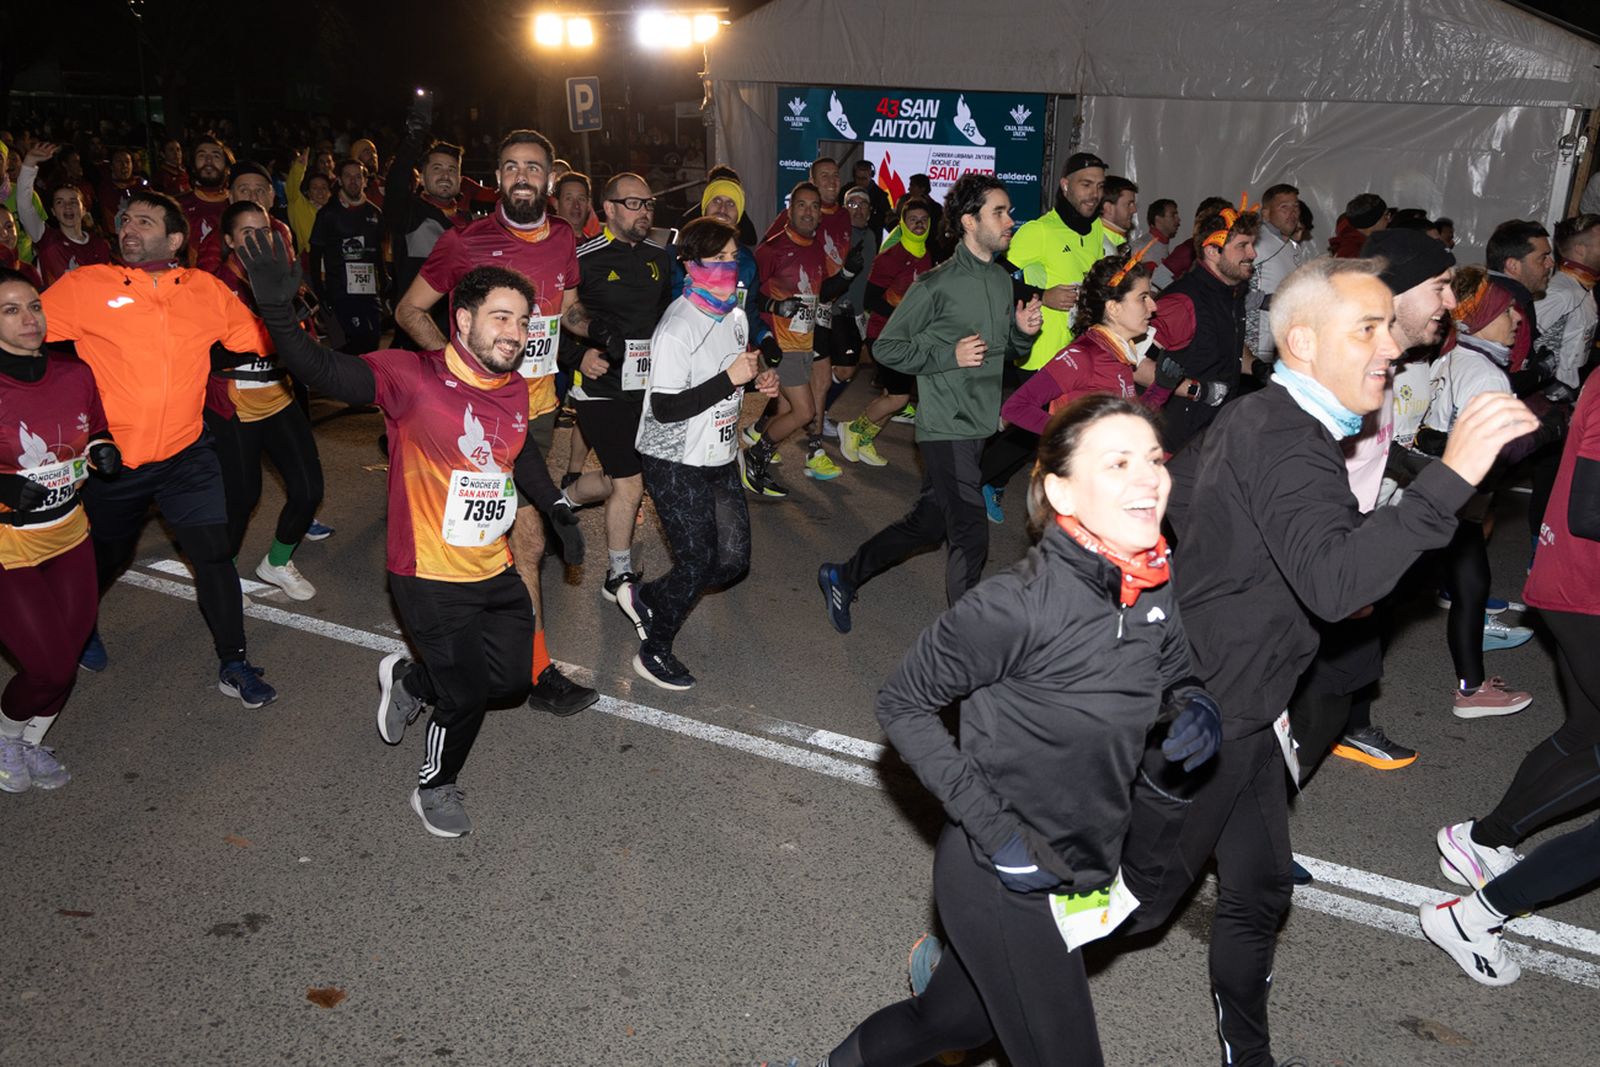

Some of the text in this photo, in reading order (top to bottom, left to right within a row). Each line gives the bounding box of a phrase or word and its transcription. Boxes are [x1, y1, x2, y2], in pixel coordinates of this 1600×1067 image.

[575, 84, 594, 125] P
[835, 117, 848, 131] 43
[869, 116, 936, 139] ANTÓN
[963, 123, 976, 137] 43
[779, 160, 813, 168] calderón
[928, 166, 960, 182] SAN
[997, 172, 1037, 181] calderón
[470, 446, 490, 465] 43
[38, 467, 70, 482] NOCHE DE
[469, 481, 493, 490] NOCHE
[492, 482, 501, 490] DE
[458, 489, 475, 498] SAN
[463, 499, 507, 522] 7395
